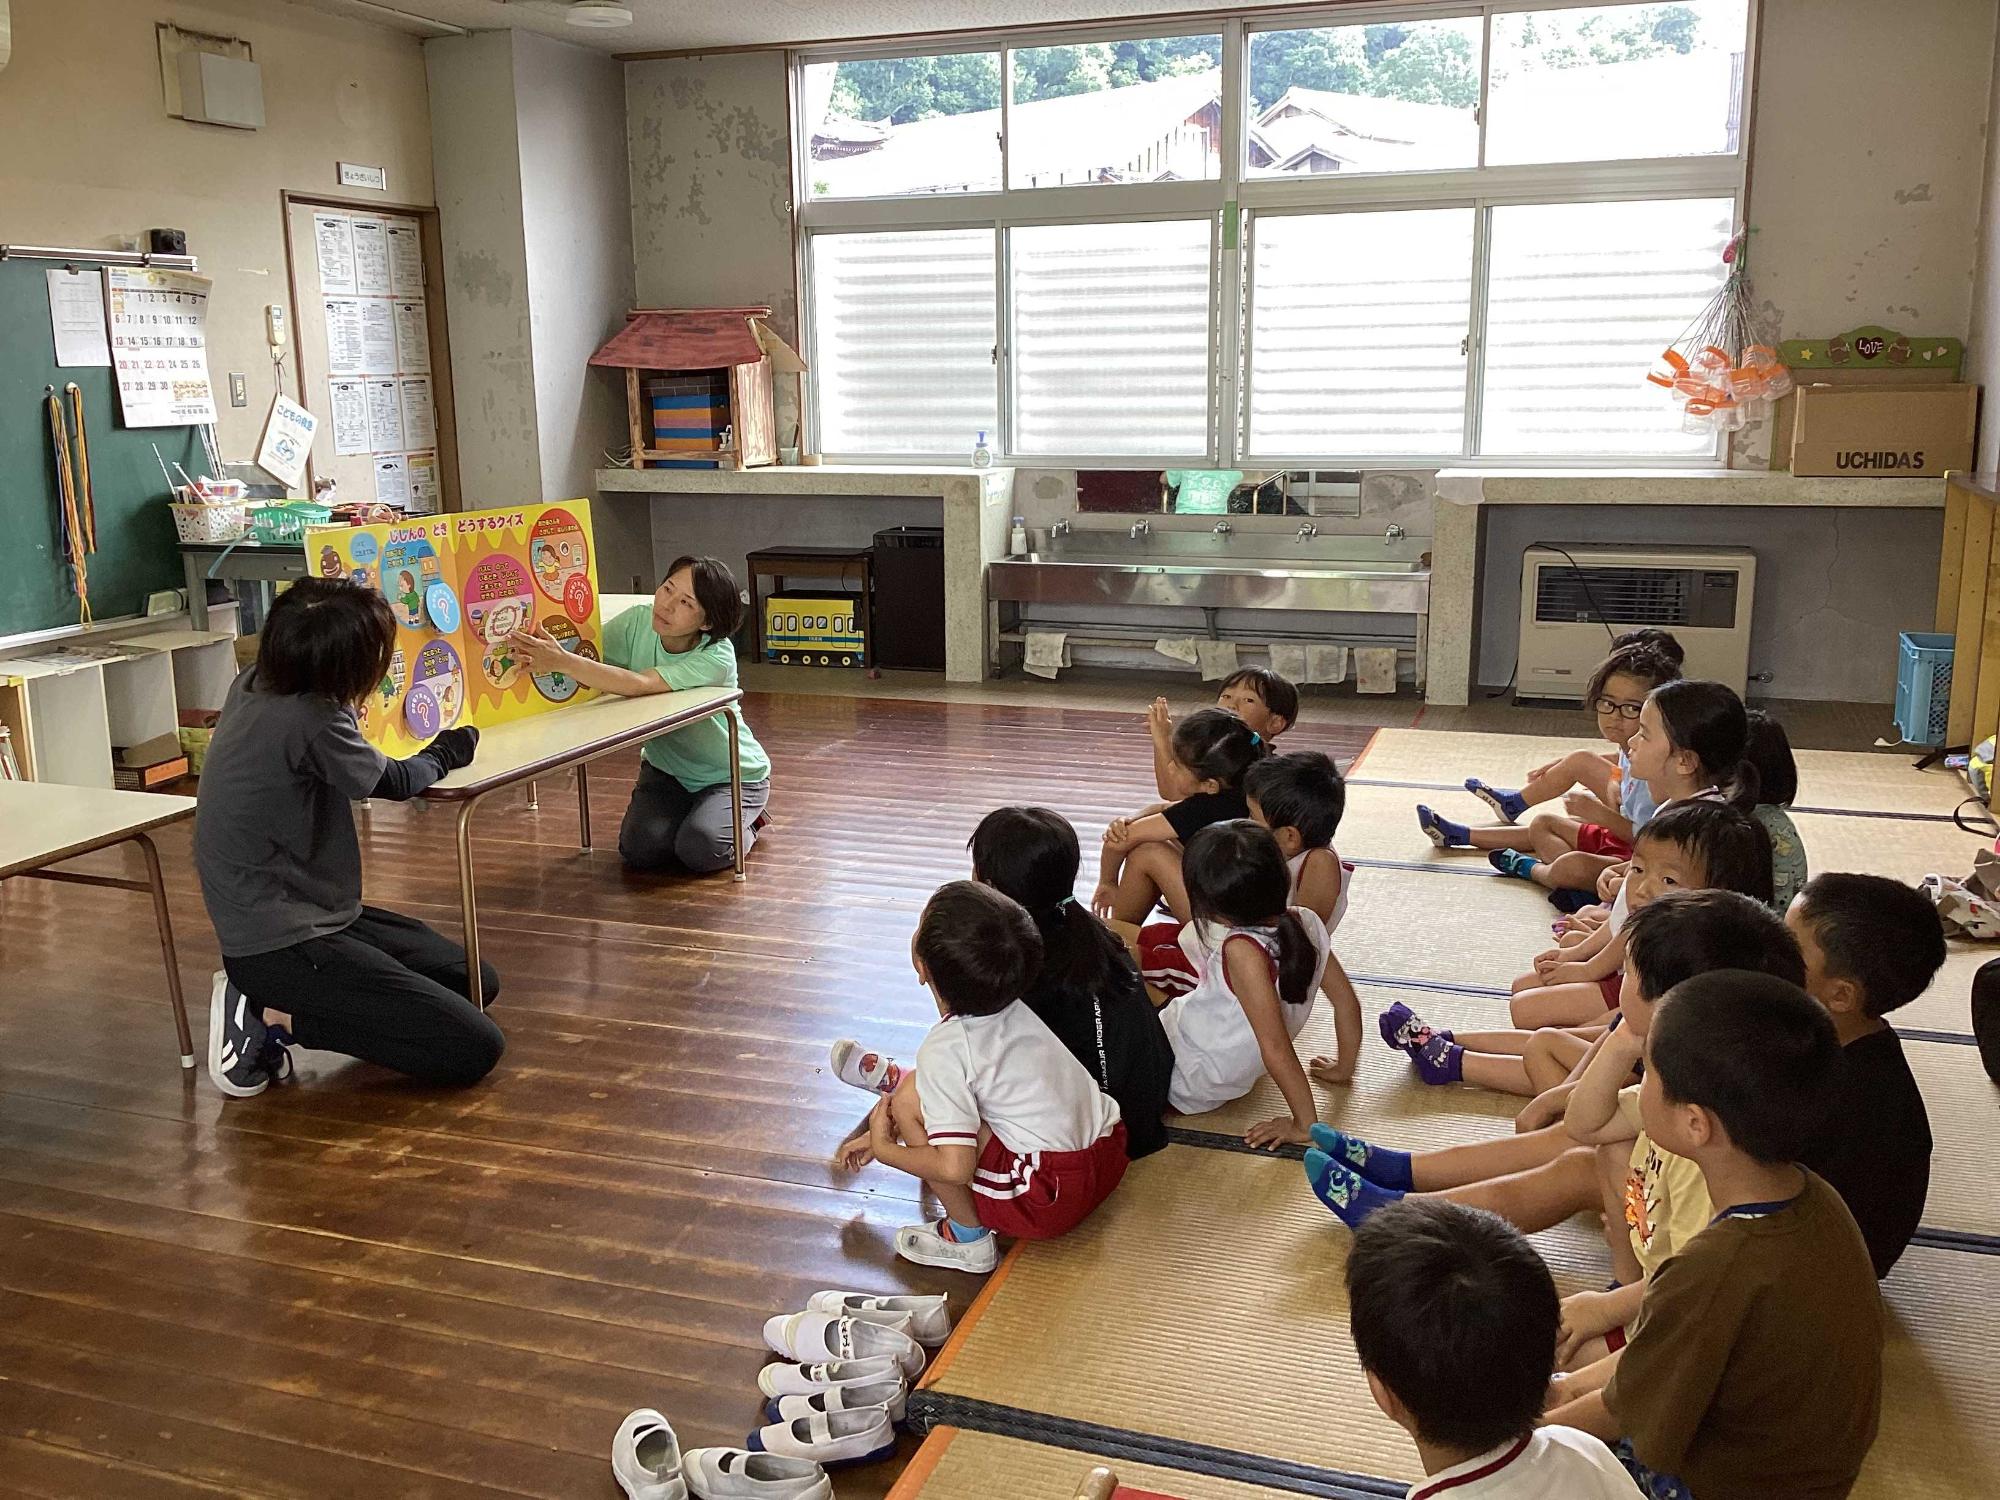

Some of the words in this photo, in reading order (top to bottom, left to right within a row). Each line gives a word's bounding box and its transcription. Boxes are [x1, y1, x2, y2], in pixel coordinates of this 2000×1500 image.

[115, 315, 120, 323] 6
[127, 315, 131, 323] 7
[139, 315, 144, 323] 8
[152, 316, 157, 324] 9
[163, 316, 171, 324] 10
[175, 316, 183, 324] 11
[188, 317, 197, 325] 12
[115, 337, 123, 346] 13
[128, 337, 136, 346] 14
[140, 337, 149, 346] 15
[153, 337, 161, 346] 16
[165, 337, 173, 346] 17
[178, 337, 185, 346] 18
[190, 337, 198, 346] 19
[1858, 339, 1884, 354] LOVE
[118, 360, 128, 369] 20
[131, 360, 140, 369] 21
[144, 360, 152, 369] 22
[156, 360, 165, 369] 23
[168, 360, 177, 369] 24
[181, 360, 189, 369] 25
[192, 360, 200, 369] 26
[122, 382, 130, 391] 27
[135, 382, 143, 391] 28
[148, 382, 156, 391] 29
[160, 382, 168, 391] 30
[1835, 451, 1925, 470] UCHIDAS
[390, 526, 426, 544] じしんの
[433, 522, 447, 537] とき
[457, 513, 524, 533] どうするクイズ
[1095, 1017, 1103, 1048] UNDER
